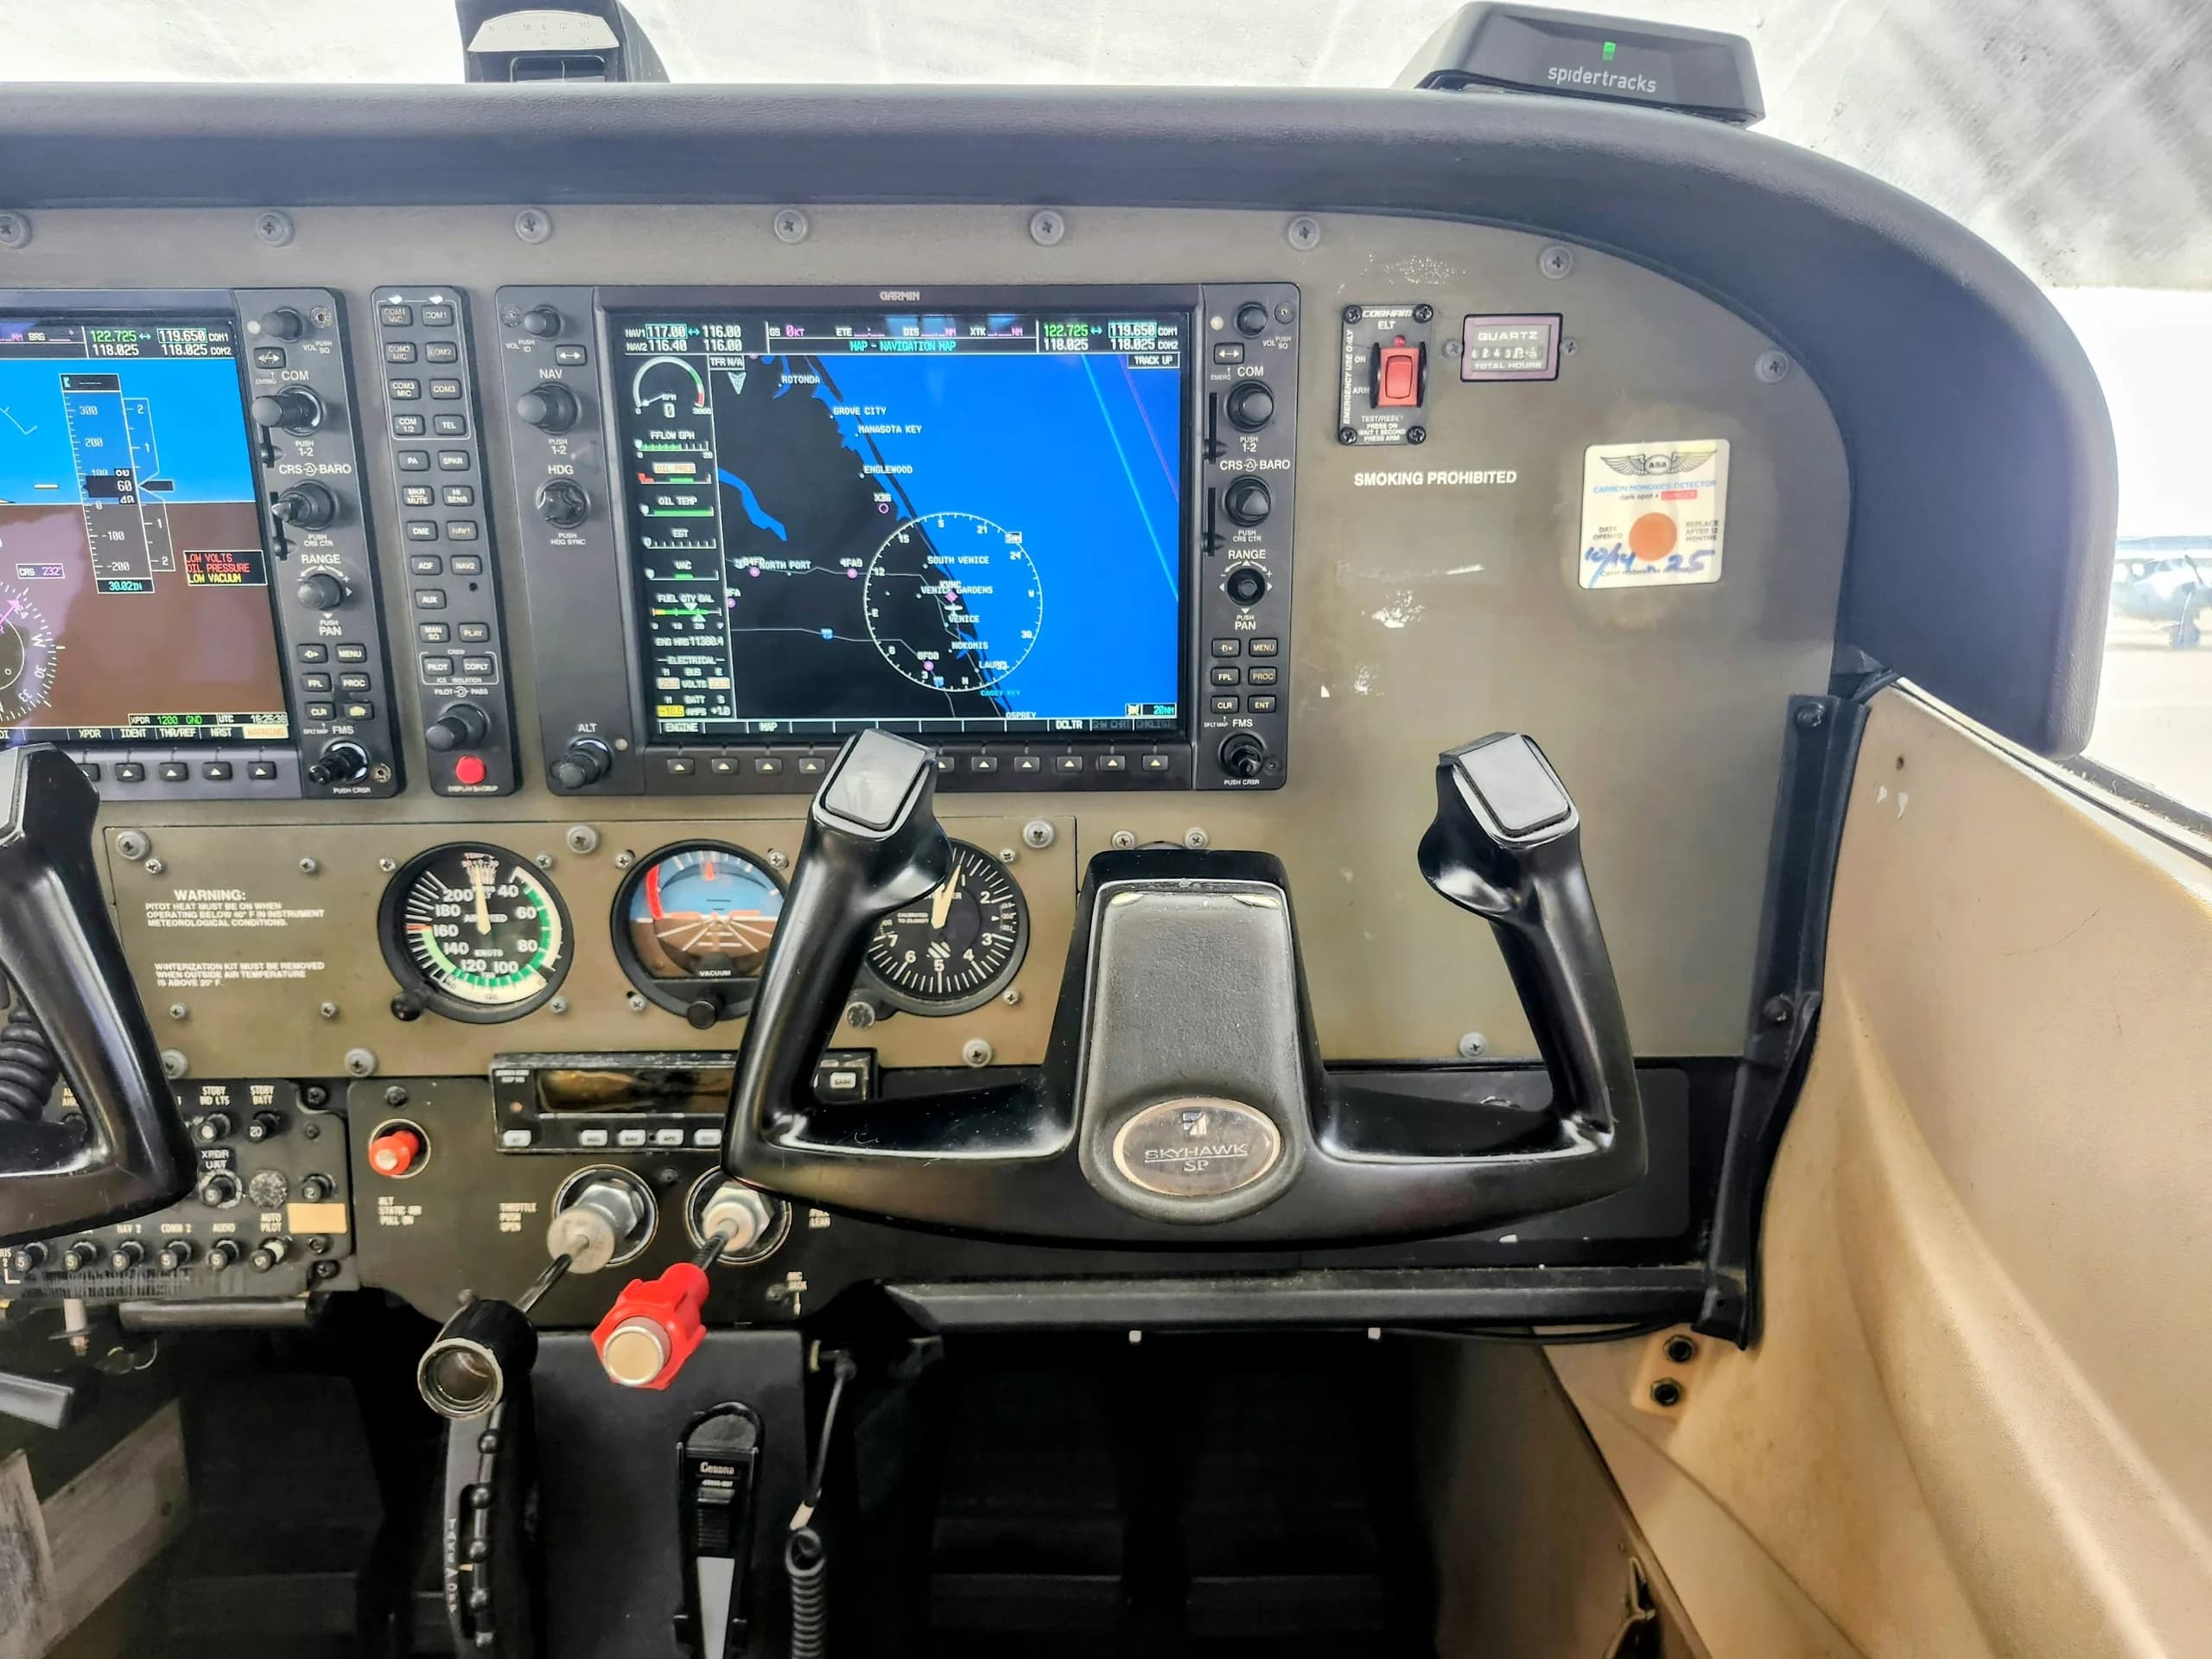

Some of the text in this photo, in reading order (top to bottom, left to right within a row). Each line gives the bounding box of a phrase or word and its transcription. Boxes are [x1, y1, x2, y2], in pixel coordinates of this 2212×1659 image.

[1548, 67, 1656, 92] spidertracks
[880, 291, 919, 302] GARMIN
[626, 326, 741, 338] NAV1 117.00 116.00
[970, 327, 986, 336] XTK
[1044, 325, 1088, 336] 122.725
[1111, 325, 1154, 336] 119.650
[91, 330, 228, 342] 122.725 119.650 COM1
[1478, 332, 1538, 340] QUARTZ
[626, 340, 742, 352] NAV2 116.40 116.00
[850, 340, 956, 352] MAP NAVIGATION MAP
[1044, 339, 1088, 350] 118.025
[1111, 339, 1155, 350] 118.025
[92, 344, 232, 356] 118.025 118.025 COM2
[711, 358, 726, 366] TFR
[1135, 356, 1173, 365] TRACK UP
[282, 372, 308, 380] COM
[539, 369, 562, 378] NAV
[1237, 367, 1263, 376] COM
[1344, 372, 1353, 424] EMERGENCY
[79, 406, 98, 415] 300
[859, 425, 922, 434] MANASOTA KEY
[86, 438, 103, 447] 200
[1242, 443, 1256, 452] 1-2
[299, 448, 314, 456] 1-2
[552, 445, 567, 454] 1-2
[279, 465, 351, 474] CRS BARO
[548, 465, 574, 474] HDG
[1220, 460, 1290, 470] CRS BARO
[1355, 471, 1516, 486] SMOKING PROHIBITED
[118, 480, 131, 491] 60
[187, 553, 232, 563] LOW VOLTS
[302, 554, 340, 563] RANGE
[1229, 550, 1265, 559] RANGE
[789, 561, 810, 569] PORT
[927, 556, 988, 564] SOUTH VENICE
[188, 563, 250, 573] OIL PRESSURE
[189, 573, 241, 582] LOW VACUUM
[320, 626, 341, 636] PAN
[952, 641, 988, 650] NOKOMIS
[157, 715, 177, 724] 1200
[219, 715, 233, 723] UTC
[333, 726, 354, 734] FMS
[578, 723, 597, 733] ALT
[1056, 721, 1082, 729] DCLTR
[79, 729, 100, 738] XPDR
[160, 728, 196, 737] TMR/REF
[211, 728, 232, 737] NRST
[174, 889, 245, 900] WARNING:
[443, 888, 473, 902] 200
[498, 885, 518, 898] 40
[981, 892, 991, 904] 2
[268, 909, 324, 918] INSTRUMENT
[435, 904, 461, 917] 180
[516, 906, 537, 919] 60
[434, 925, 459, 937] 160
[888, 935, 898, 947] 7
[982, 933, 992, 945] 3
[444, 942, 469, 955] 140
[518, 940, 537, 952] 80
[906, 950, 916, 963] 6
[963, 949, 974, 961] 4
[461, 959, 486, 972] 120
[493, 961, 518, 973] 100
[934, 959, 944, 971] 5
[253, 1096, 272, 1105] BATT
[1145, 1144, 1248, 1160] SKYHAWK
[1184, 1160, 1209, 1171] SP
[161, 1224, 182, 1233] COMM
[213, 1224, 236, 1233] AUDIO
[700, 1462, 734, 1475] Cessna
